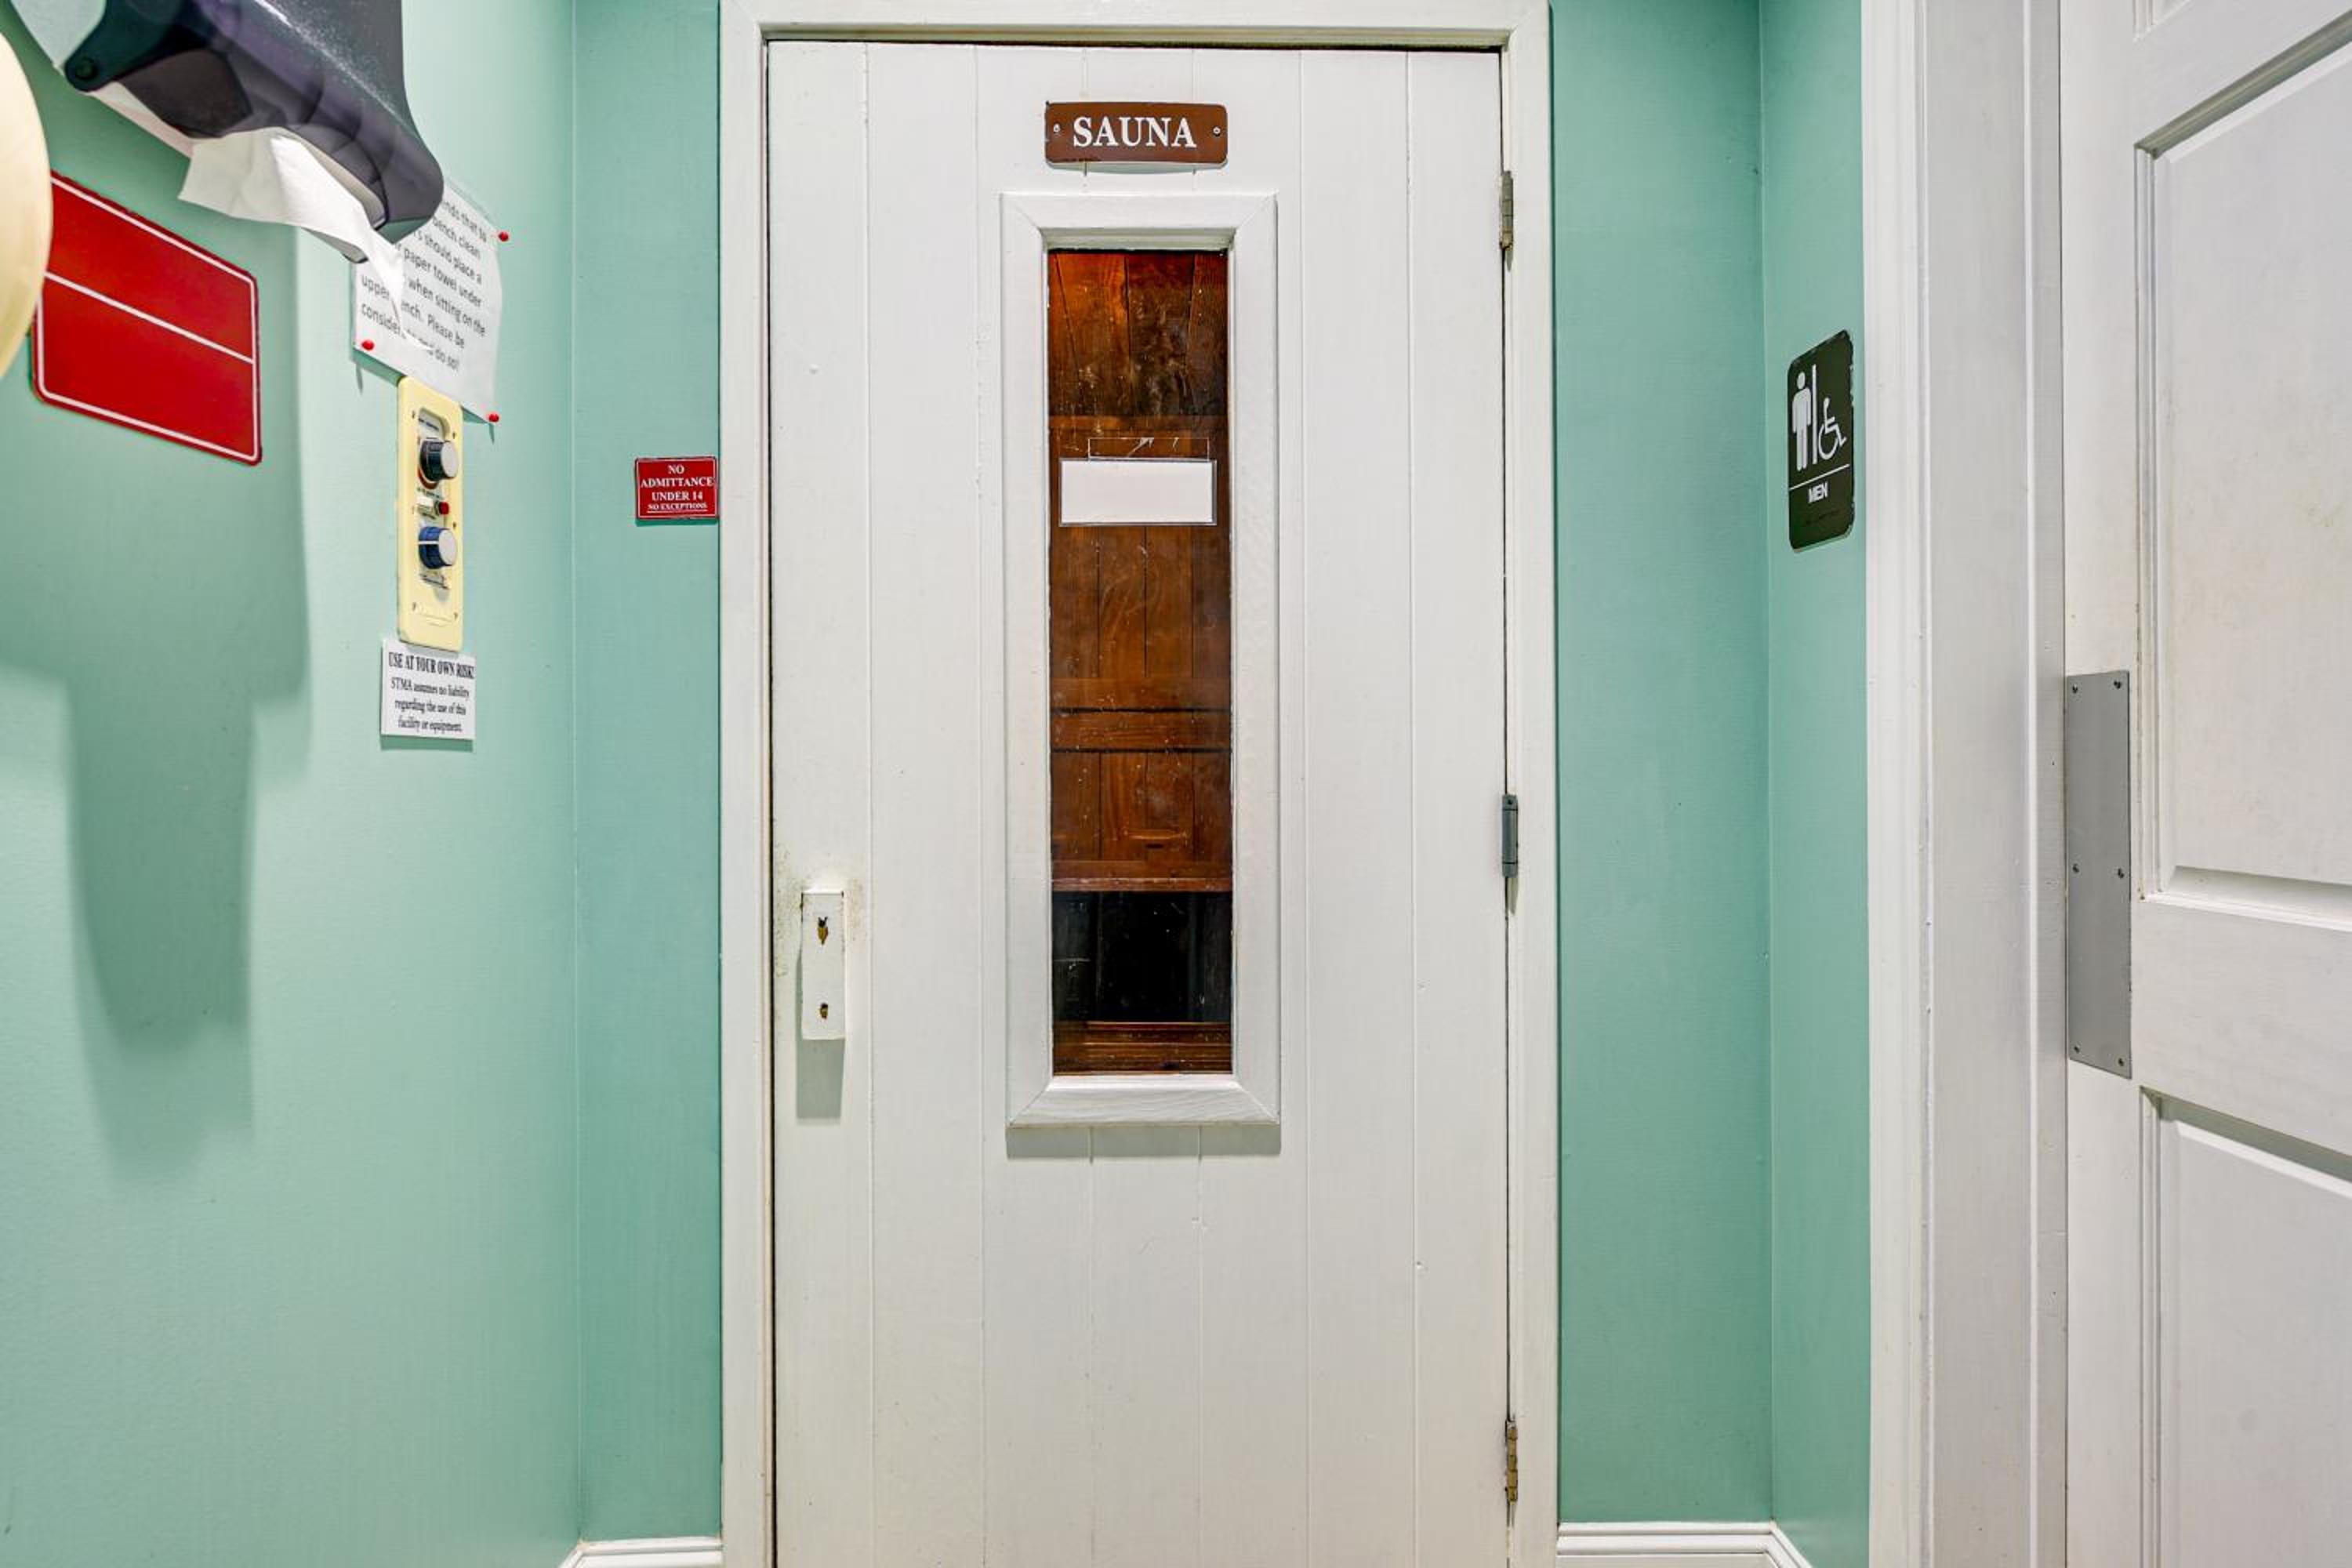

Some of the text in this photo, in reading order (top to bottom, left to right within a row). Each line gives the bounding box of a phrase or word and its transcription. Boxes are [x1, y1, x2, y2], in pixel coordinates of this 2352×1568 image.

[1073, 115, 1197, 147] SAUNA
[424, 234, 452, 263] should
[453, 256, 475, 281] place
[404, 248, 481, 308] paper towel under
[408, 277, 485, 336] when sitting on the
[427, 313, 453, 342] Please
[455, 330, 464, 349] be
[667, 463, 685, 474] NO
[641, 477, 714, 488] ADMITTANCE
[1808, 481, 1828, 503] MEN
[652, 490, 703, 501] UNDER 14
[661, 501, 708, 510] EXCEPTIONS
[388, 652, 403, 669] USE
[405, 655, 414, 670] AT
[416, 656, 436, 673] YOUR
[437, 660, 455, 676] OWN
[390, 677, 469, 700] STMA assumes no liability
[394, 698, 425, 713] regarding
[426, 699, 436, 712] the
[448, 702, 455, 713] of
[456, 703, 466, 715] this
[398, 715, 420, 732] facility
